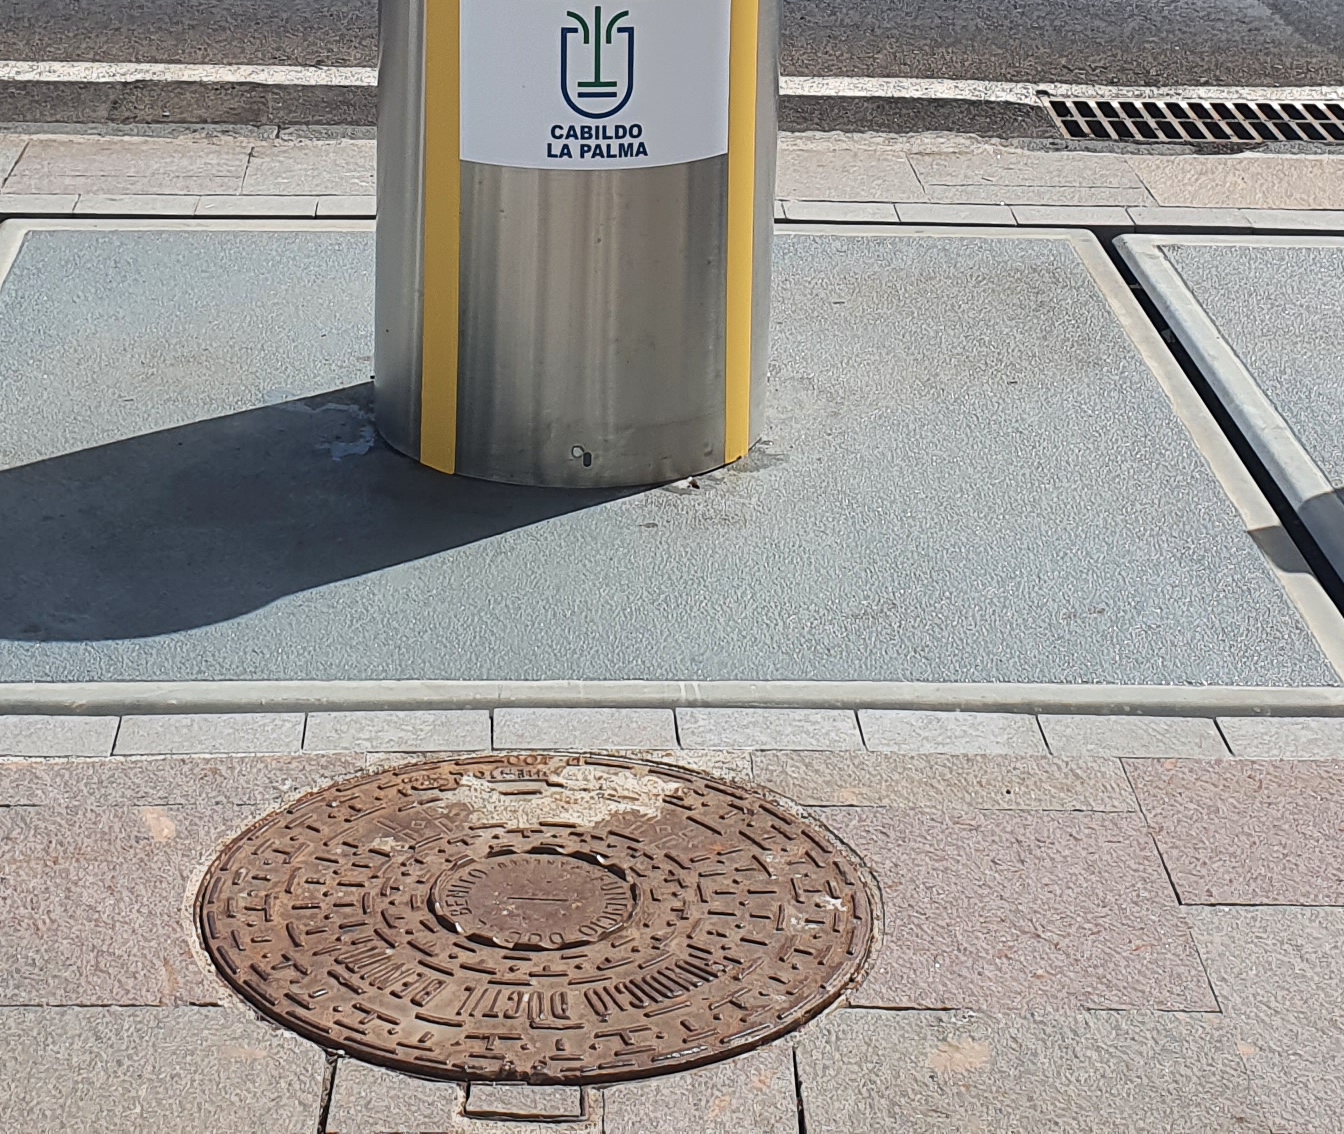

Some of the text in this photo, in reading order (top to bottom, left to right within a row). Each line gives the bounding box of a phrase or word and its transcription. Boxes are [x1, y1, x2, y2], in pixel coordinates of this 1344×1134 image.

[550, 123, 643, 141] CABILDO
[546, 141, 649, 159] LA PALMA
[455, 984, 571, 1021] DUCTIL
